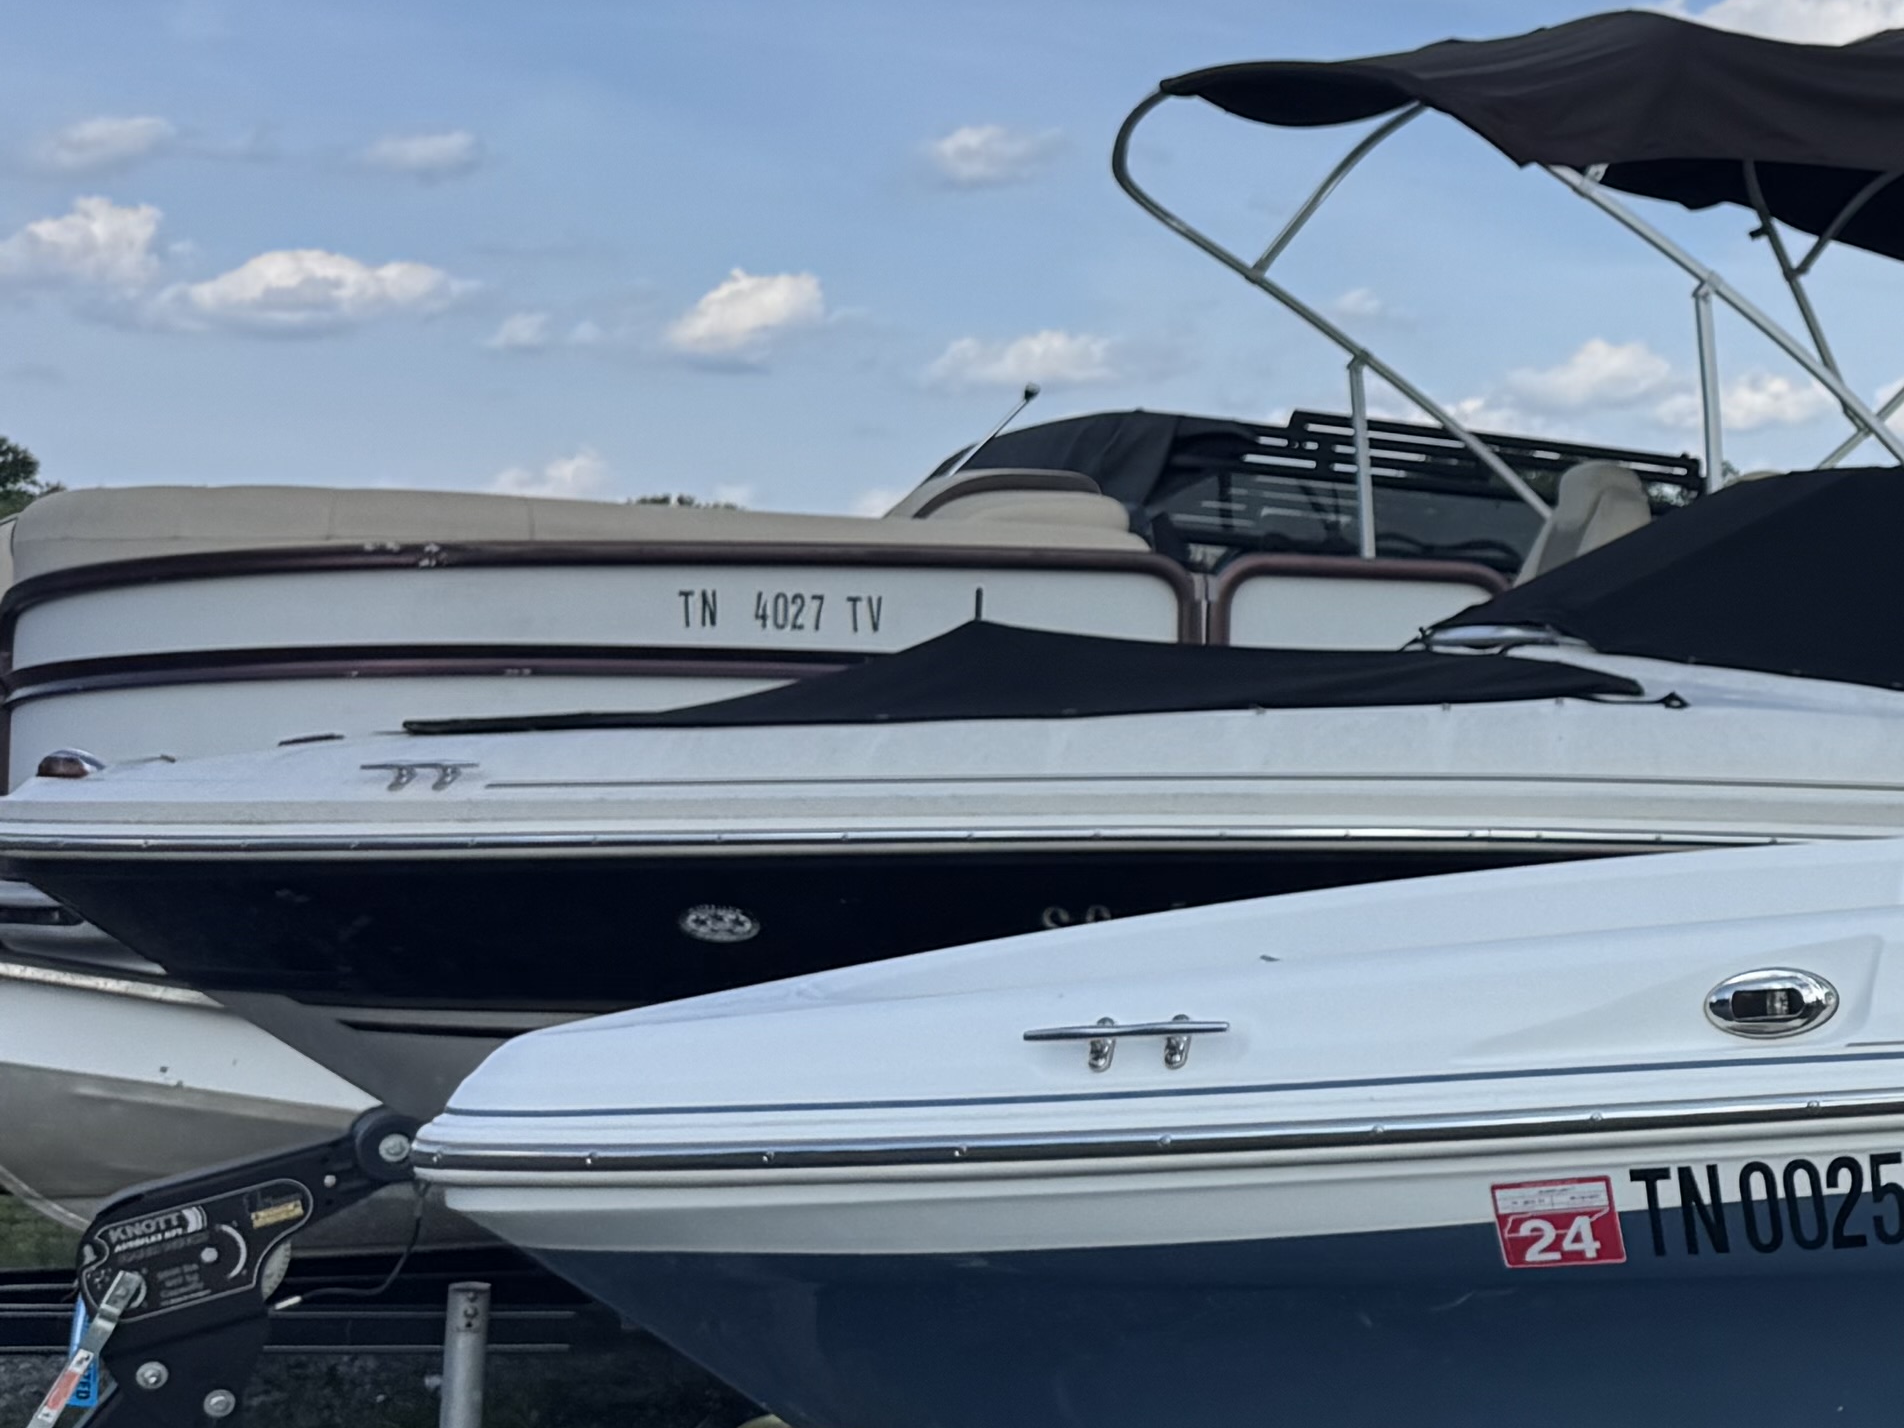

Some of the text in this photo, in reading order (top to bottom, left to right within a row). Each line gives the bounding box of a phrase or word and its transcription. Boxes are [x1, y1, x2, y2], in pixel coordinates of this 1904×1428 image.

[678, 589, 883, 633] TN 4027 TV
[108, 1212, 180, 1245] KNOTT
[1525, 1216, 1601, 1262] 24
